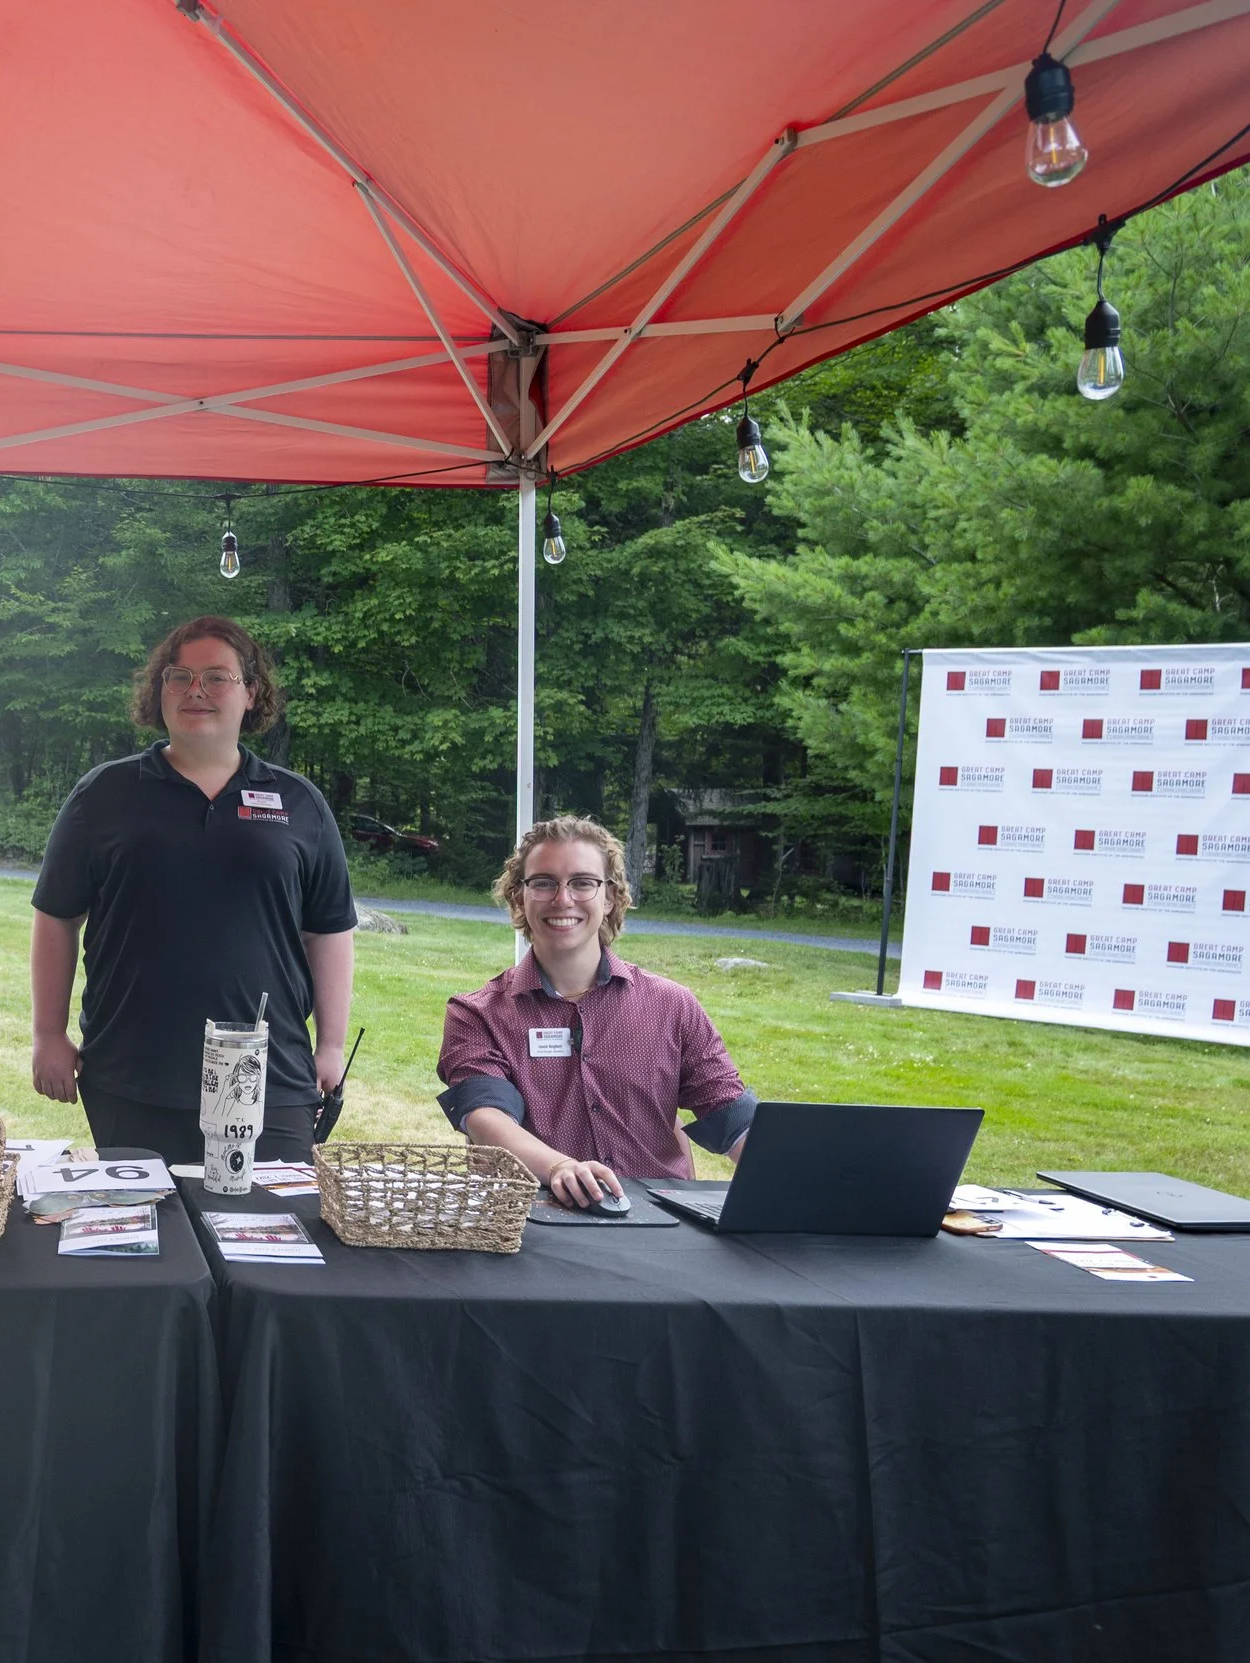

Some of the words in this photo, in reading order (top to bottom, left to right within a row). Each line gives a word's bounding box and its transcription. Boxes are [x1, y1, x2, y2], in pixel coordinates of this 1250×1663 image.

[1056, 776, 1101, 784] SAGAMORE
[1157, 779, 1206, 787] SAGAMORE
[253, 814, 289, 822] SAGAMORE
[1001, 833, 1045, 842] SAGAMORE
[1098, 838, 1146, 847] SAGAMORE
[953, 880, 996, 889] SAGAMORE
[1047, 886, 1093, 895] SAGAMORE
[1148, 892, 1196, 903] SAGAMORE
[993, 935, 1036, 945] SAGAMORE
[1090, 943, 1137, 953] SAGAMORE
[1221, 945, 1244, 953] CAMP
[1192, 951, 1243, 962] SAGAMORE
[945, 980, 987, 990] SAGAMORE
[1038, 989, 1084, 1000] SAGAMORE
[1139, 991, 1162, 999] GREAT
[1165, 992, 1187, 1001] CAMP
[1138, 999, 1186, 1010] SAGAMORE
[225, 1125, 253, 1139] 1989
